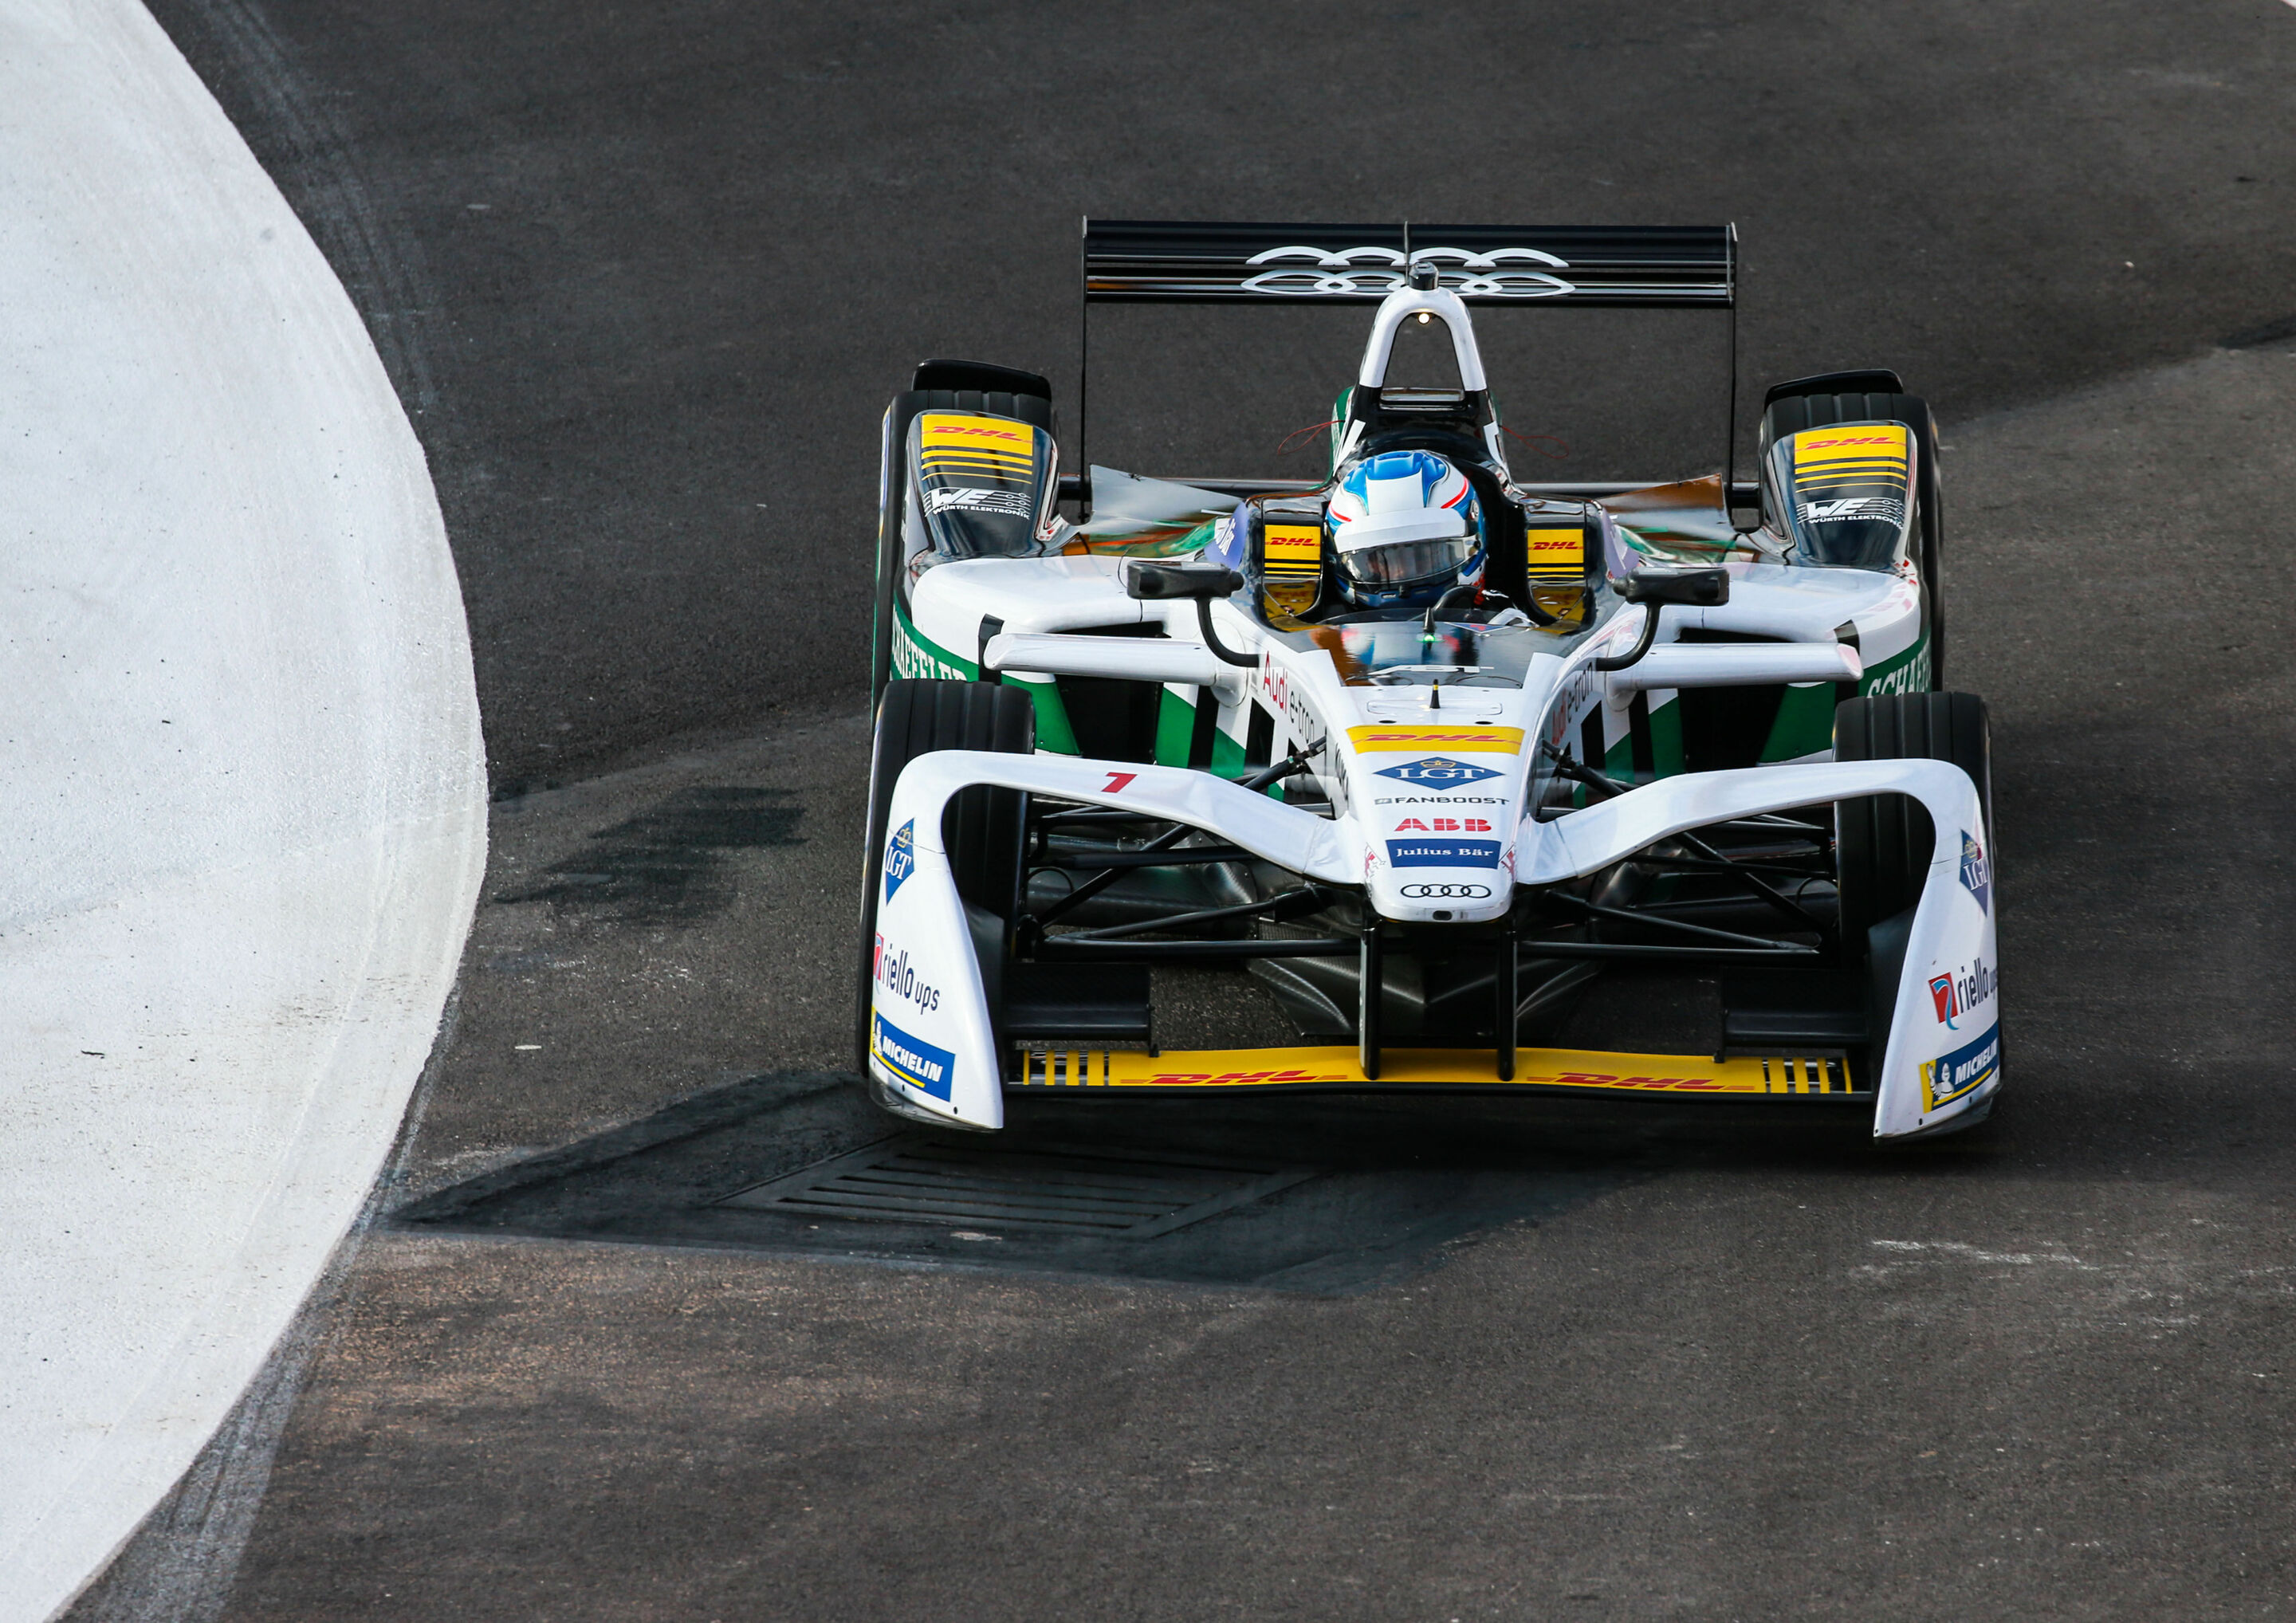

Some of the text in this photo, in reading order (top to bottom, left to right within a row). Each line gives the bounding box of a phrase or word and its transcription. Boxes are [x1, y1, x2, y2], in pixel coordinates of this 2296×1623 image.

[931, 426, 1024, 442] DHL
[1806, 437, 1896, 450] DHL
[931, 489, 995, 508] WE
[933, 504, 1030, 521] WÜRTH ELEKTRONIK
[1807, 498, 1873, 518] WE
[1270, 536, 1315, 547] DHL
[1533, 541, 1578, 550] DHL
[1263, 650, 1288, 715] Audi
[1395, 768, 1485, 779] LGT
[1394, 818, 1492, 831] ABB
[1397, 847, 1452, 857] Julius
[886, 846, 912, 880] LGT
[882, 943, 940, 1016] riello ups
[1958, 957, 1989, 1014] riello
[883, 1035, 944, 1083] MICHELIN
[1148, 1069, 1319, 1084] DHL
[1555, 1071, 1725, 1091] DHL
